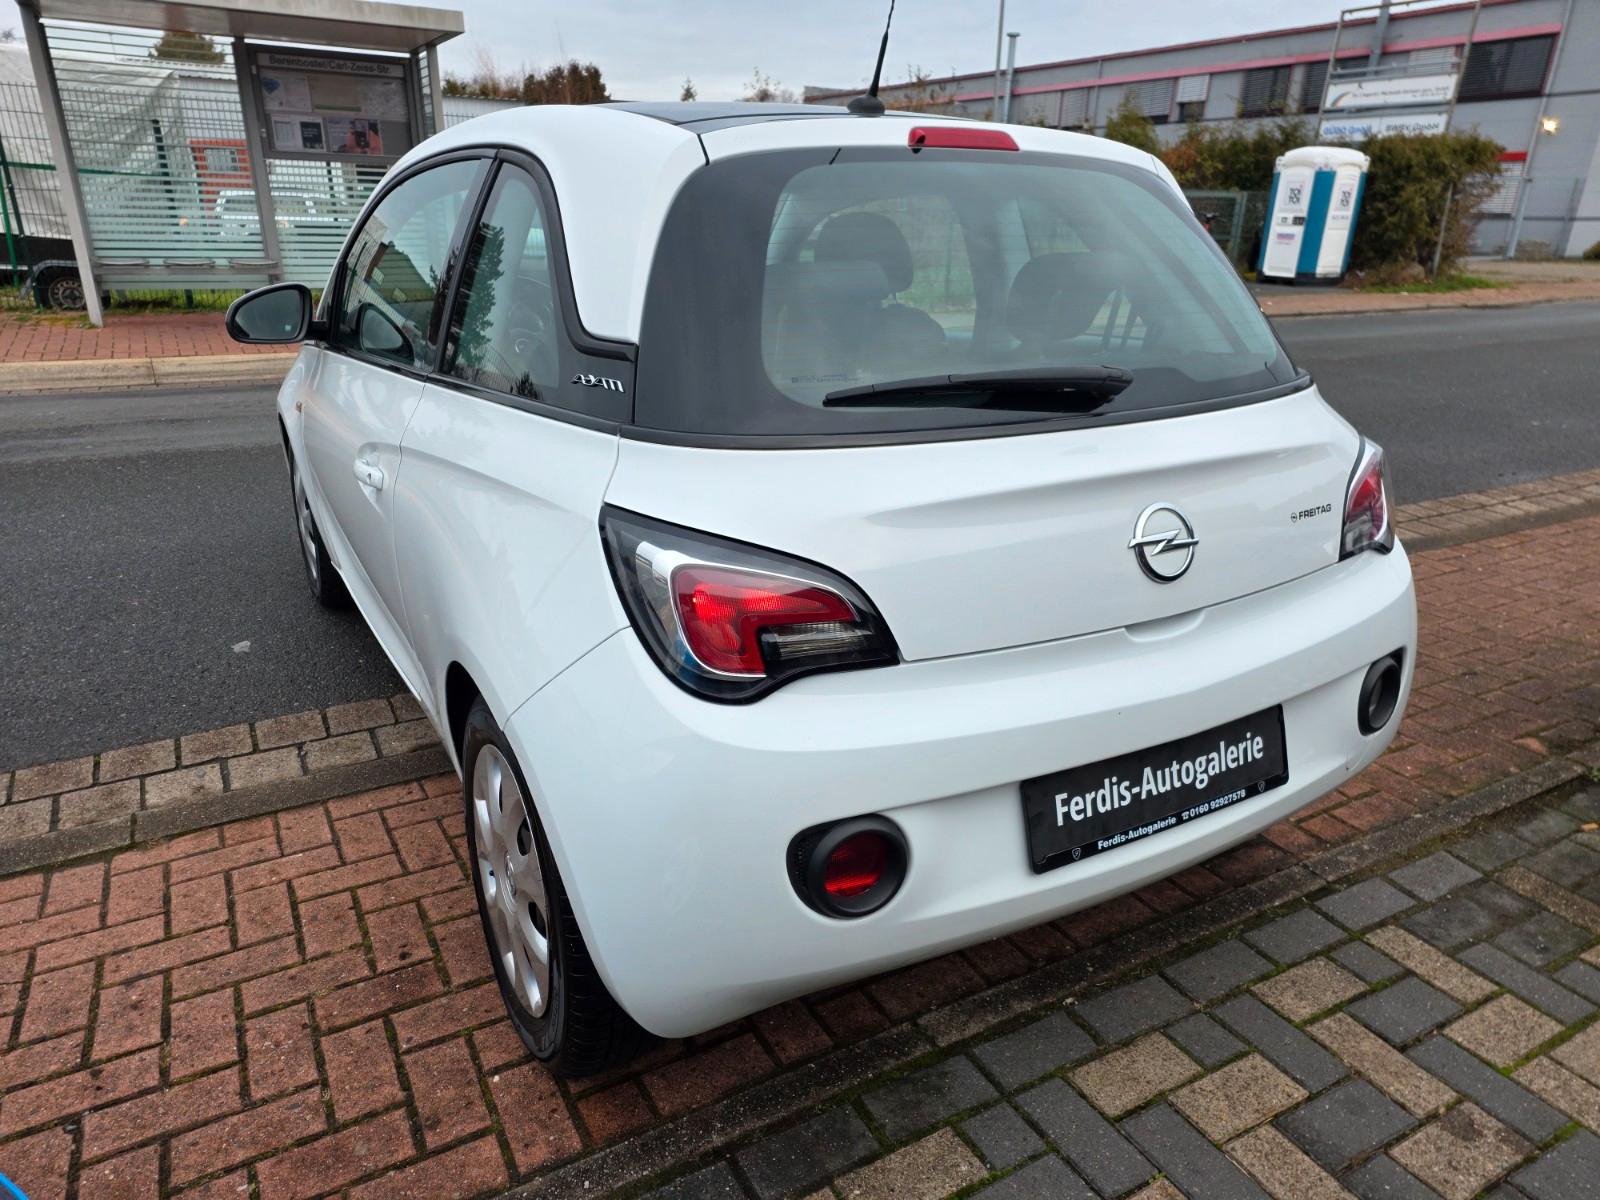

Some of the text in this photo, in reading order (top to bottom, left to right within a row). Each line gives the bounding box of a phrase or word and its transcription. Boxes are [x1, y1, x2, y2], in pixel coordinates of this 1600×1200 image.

[1298, 503, 1332, 521] FREITAG
[1054, 731, 1265, 827] Ferdis-Autogalerie
[1097, 788, 1246, 850] Ferdis-Autogalerie 0160 92927578
